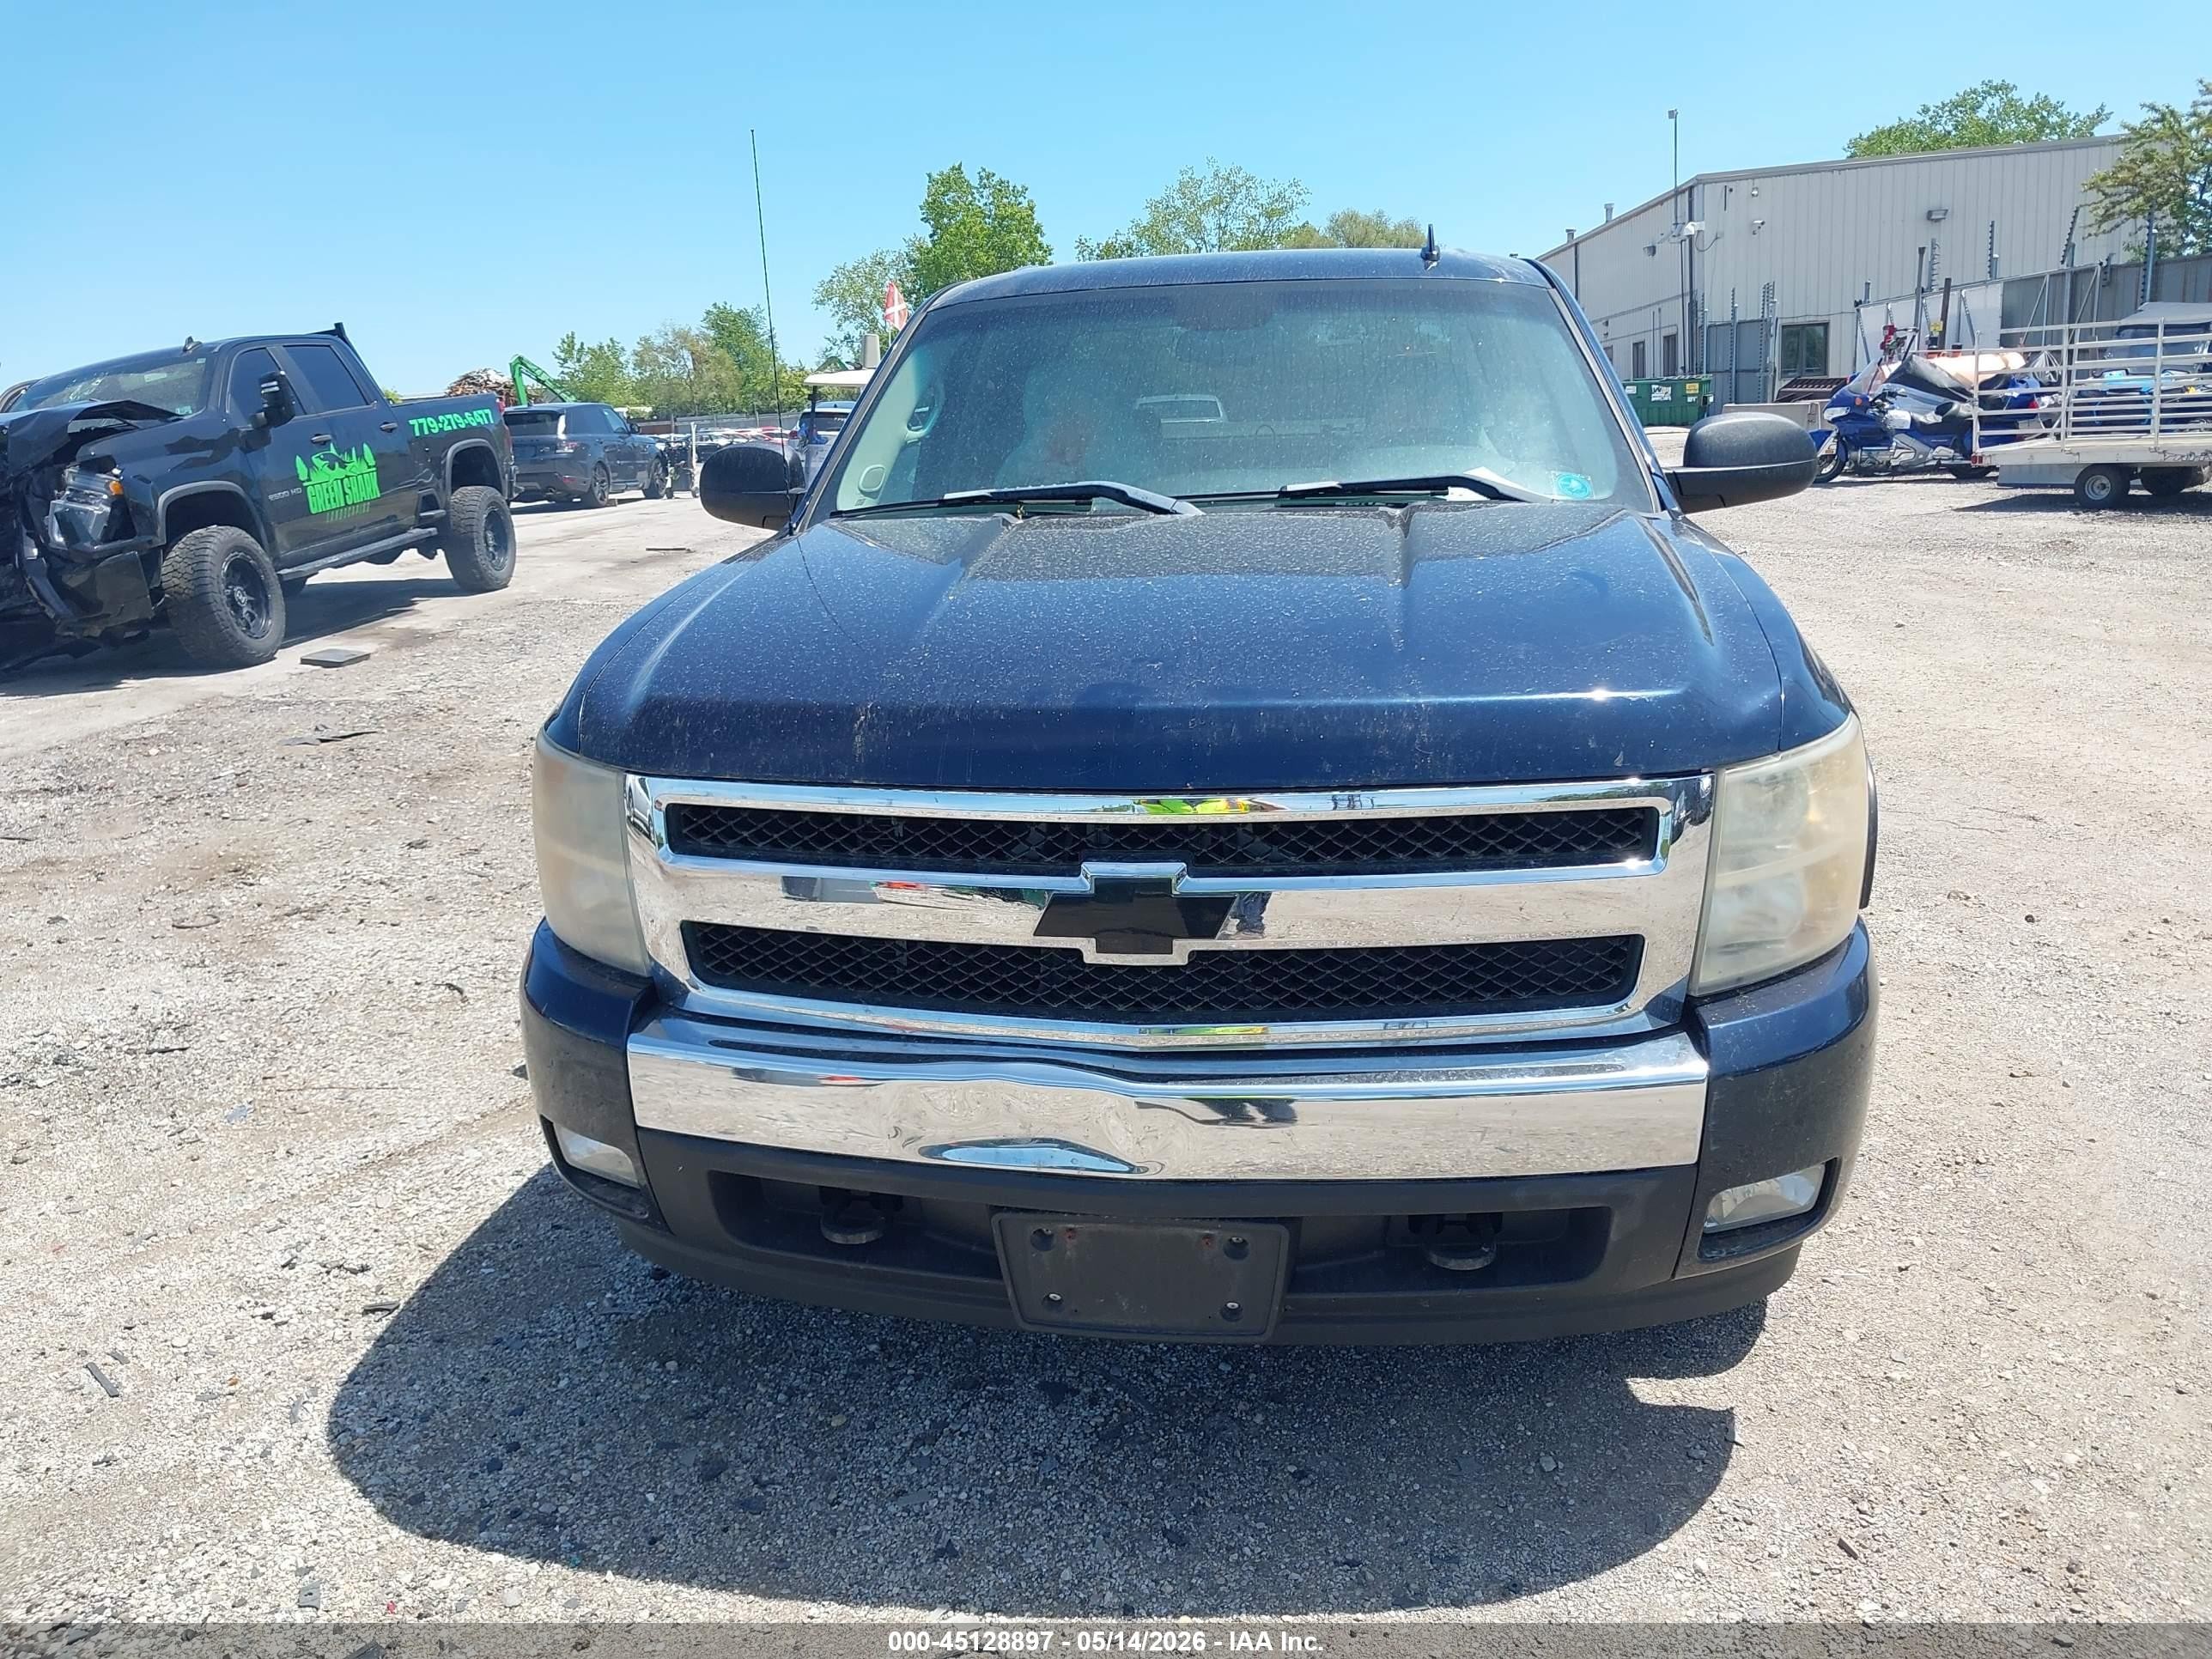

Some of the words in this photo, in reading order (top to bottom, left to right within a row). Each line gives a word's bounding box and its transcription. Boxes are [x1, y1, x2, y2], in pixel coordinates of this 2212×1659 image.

[409, 409, 494, 436] 779-279-6477
[290, 487, 302, 495] HD
[307, 479, 345, 514] GREEN
[343, 471, 380, 505] SHARK
